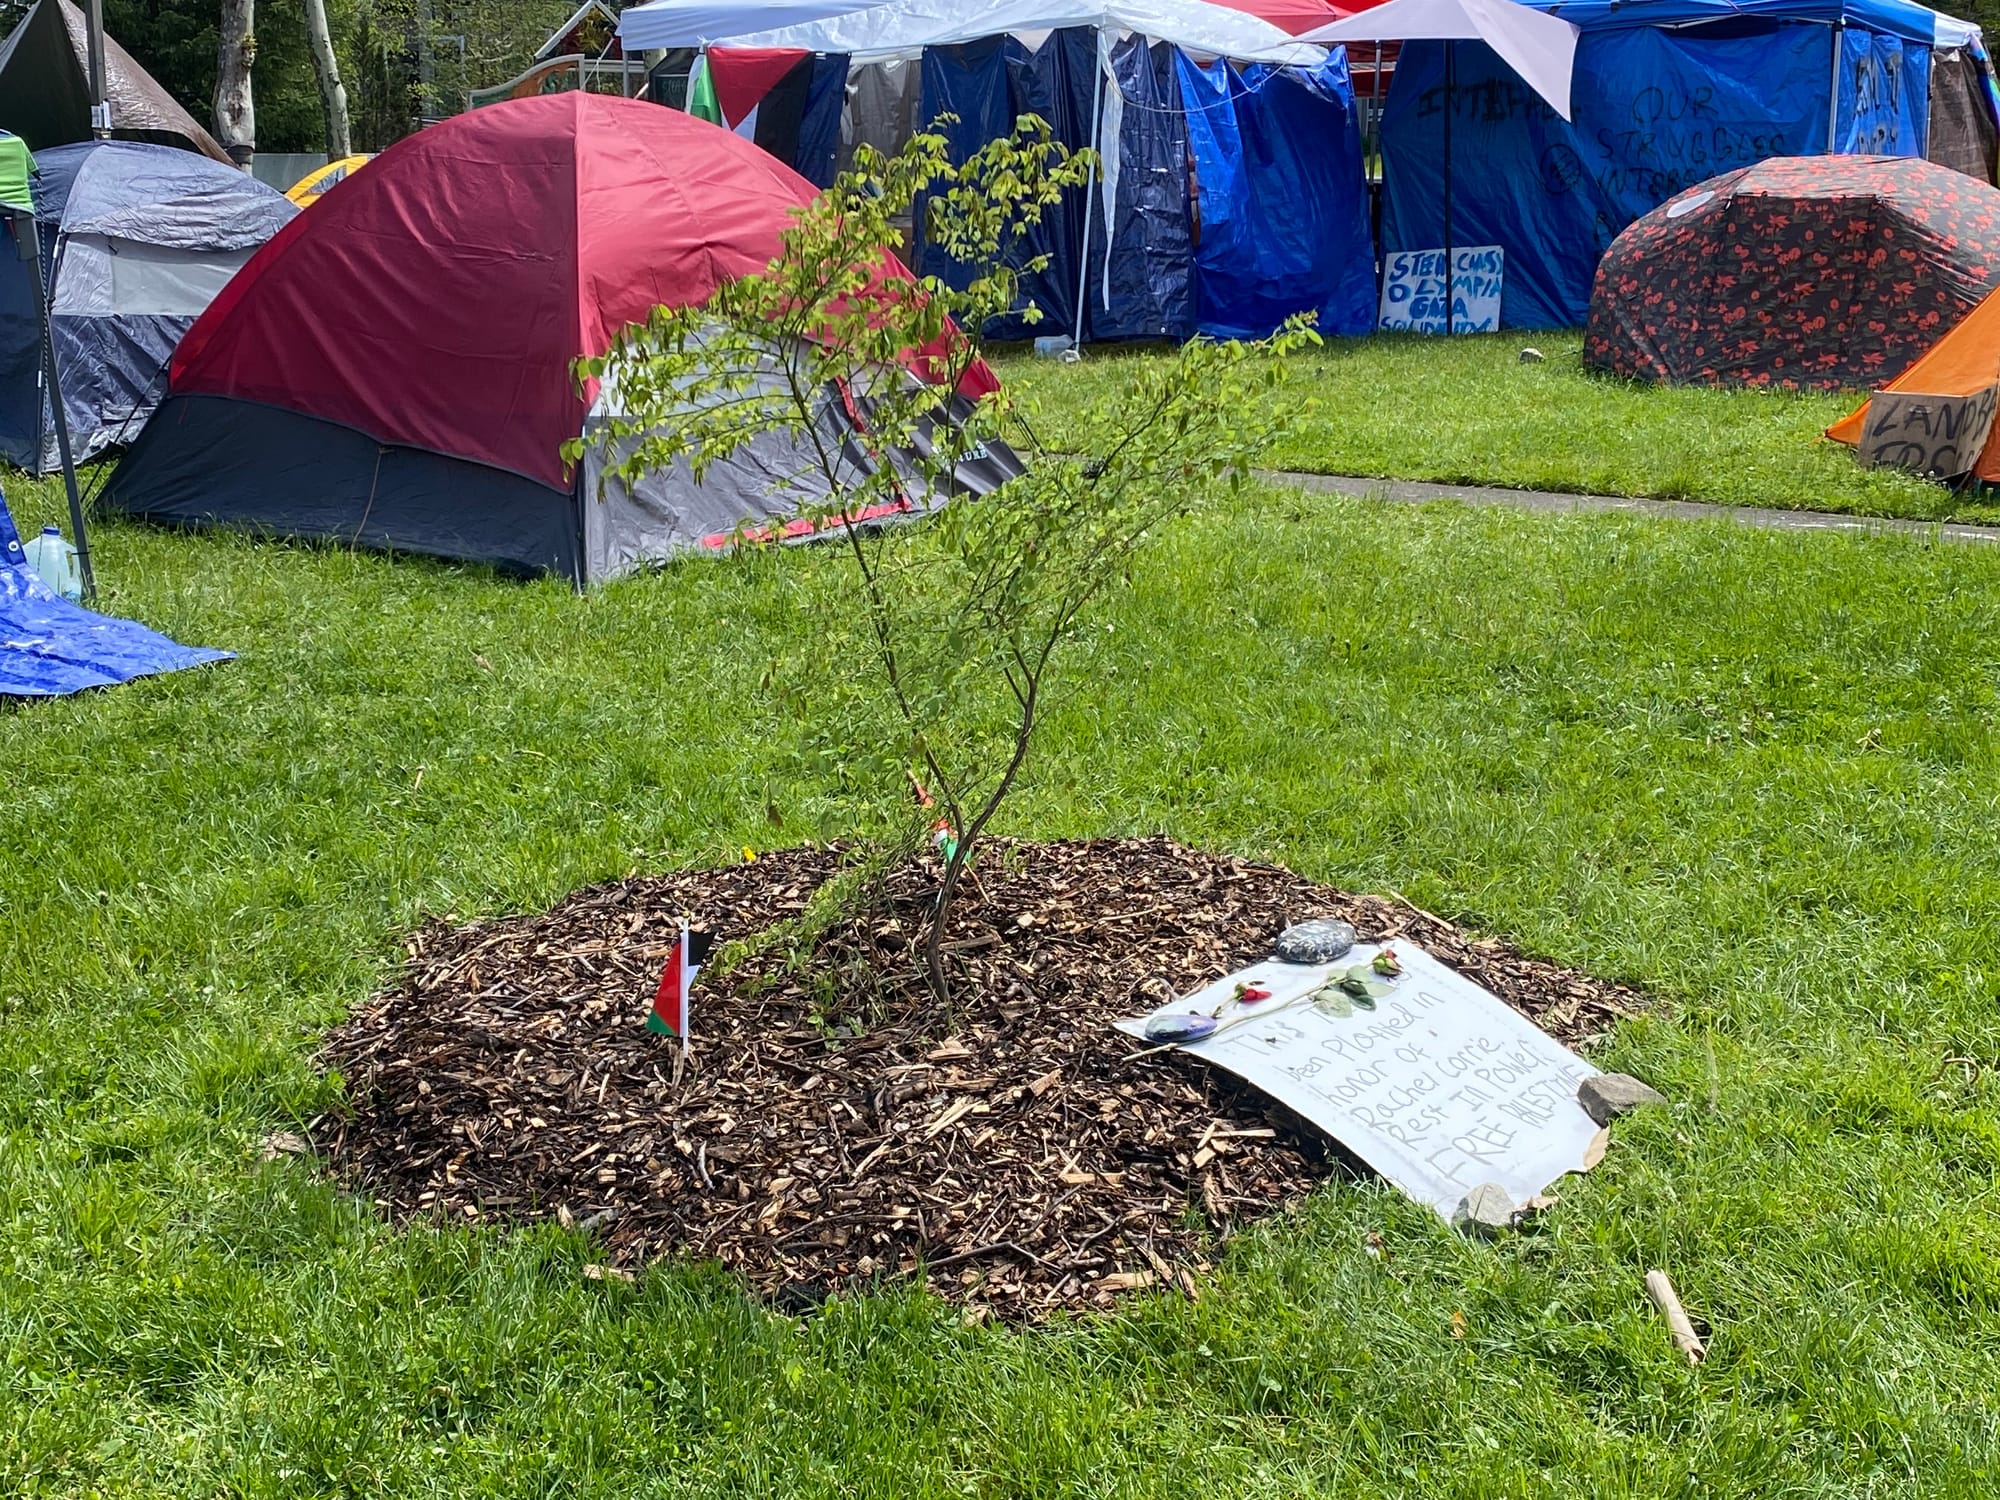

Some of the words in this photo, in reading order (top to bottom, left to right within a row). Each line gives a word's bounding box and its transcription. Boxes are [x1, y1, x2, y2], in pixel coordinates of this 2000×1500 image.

[1632, 86, 1719, 125] OUR
[1597, 127, 1785, 164] STRUGGLES
[1411, 991, 1446, 1009] in
[1309, 1058, 1389, 1107] honor
[1349, 1071, 1441, 1132] Rachel
[1388, 1104, 1450, 1152] Rest
[1424, 1115, 1518, 1190] FREE
